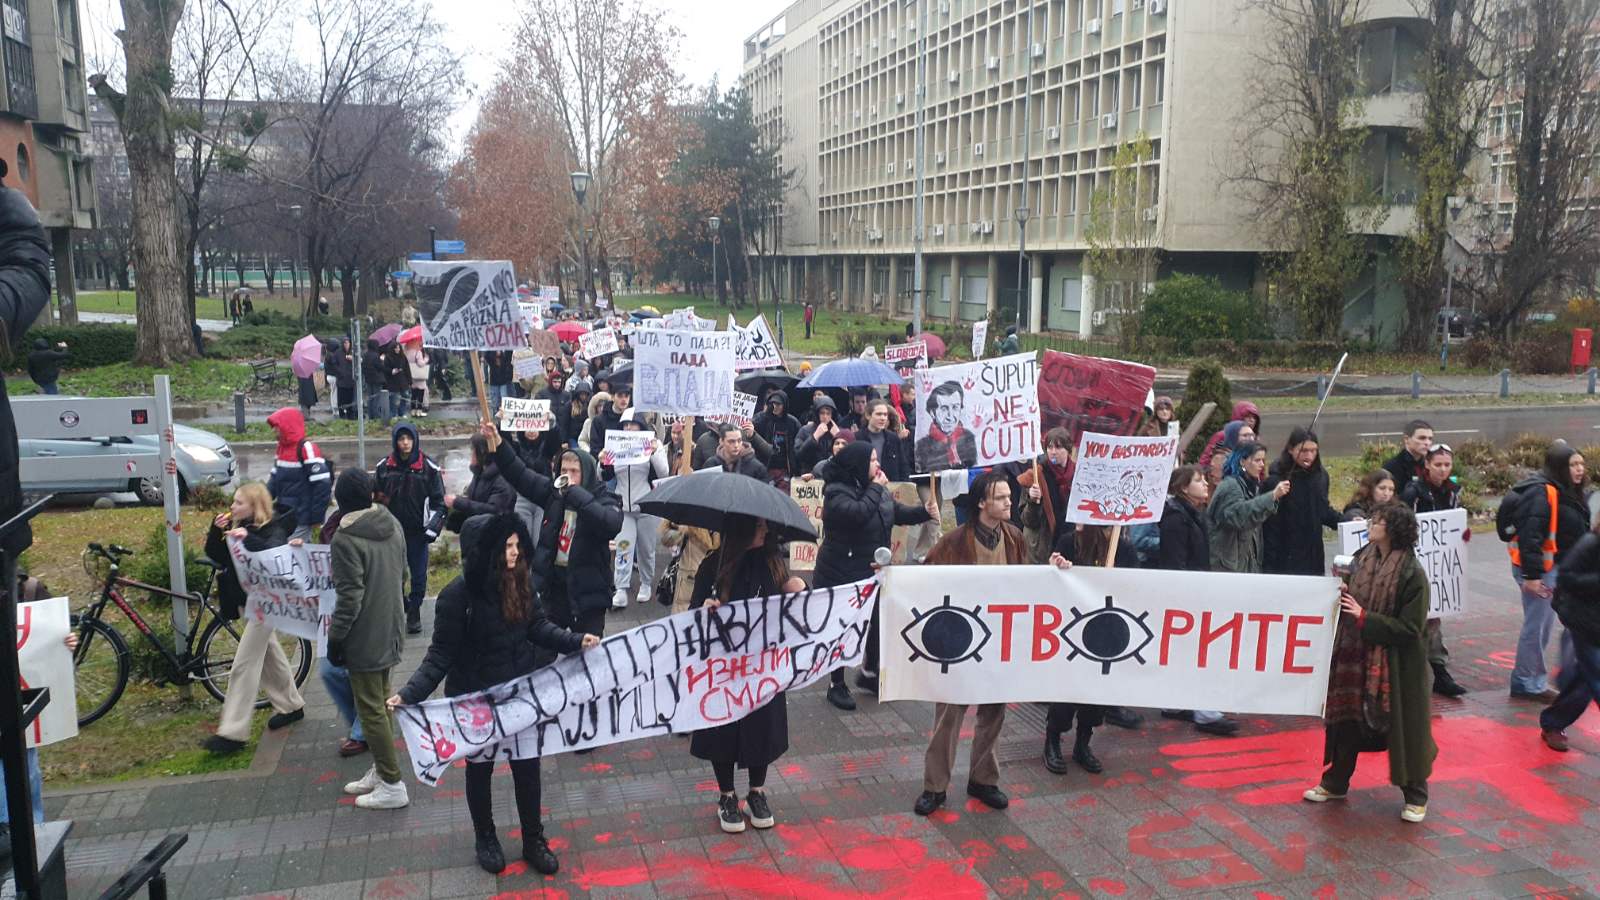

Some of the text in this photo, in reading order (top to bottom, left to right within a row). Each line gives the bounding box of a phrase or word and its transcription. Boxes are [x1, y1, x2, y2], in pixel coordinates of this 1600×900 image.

[463, 299, 512, 328] PRIZNA
[637, 332, 731, 350] ШТА ТО ПАДА?!
[670, 352, 708, 368] ПАДА
[981, 360, 1036, 396] ŠUPUT
[993, 395, 1022, 422] NE
[508, 418, 546, 429] У СТРАХУ
[981, 418, 1036, 460] ĆUTI
[1084, 438, 1176, 459] YOU BASTARDS!
[685, 644, 791, 694] ИЗНЕЛИ
[699, 676, 780, 723] СМО
